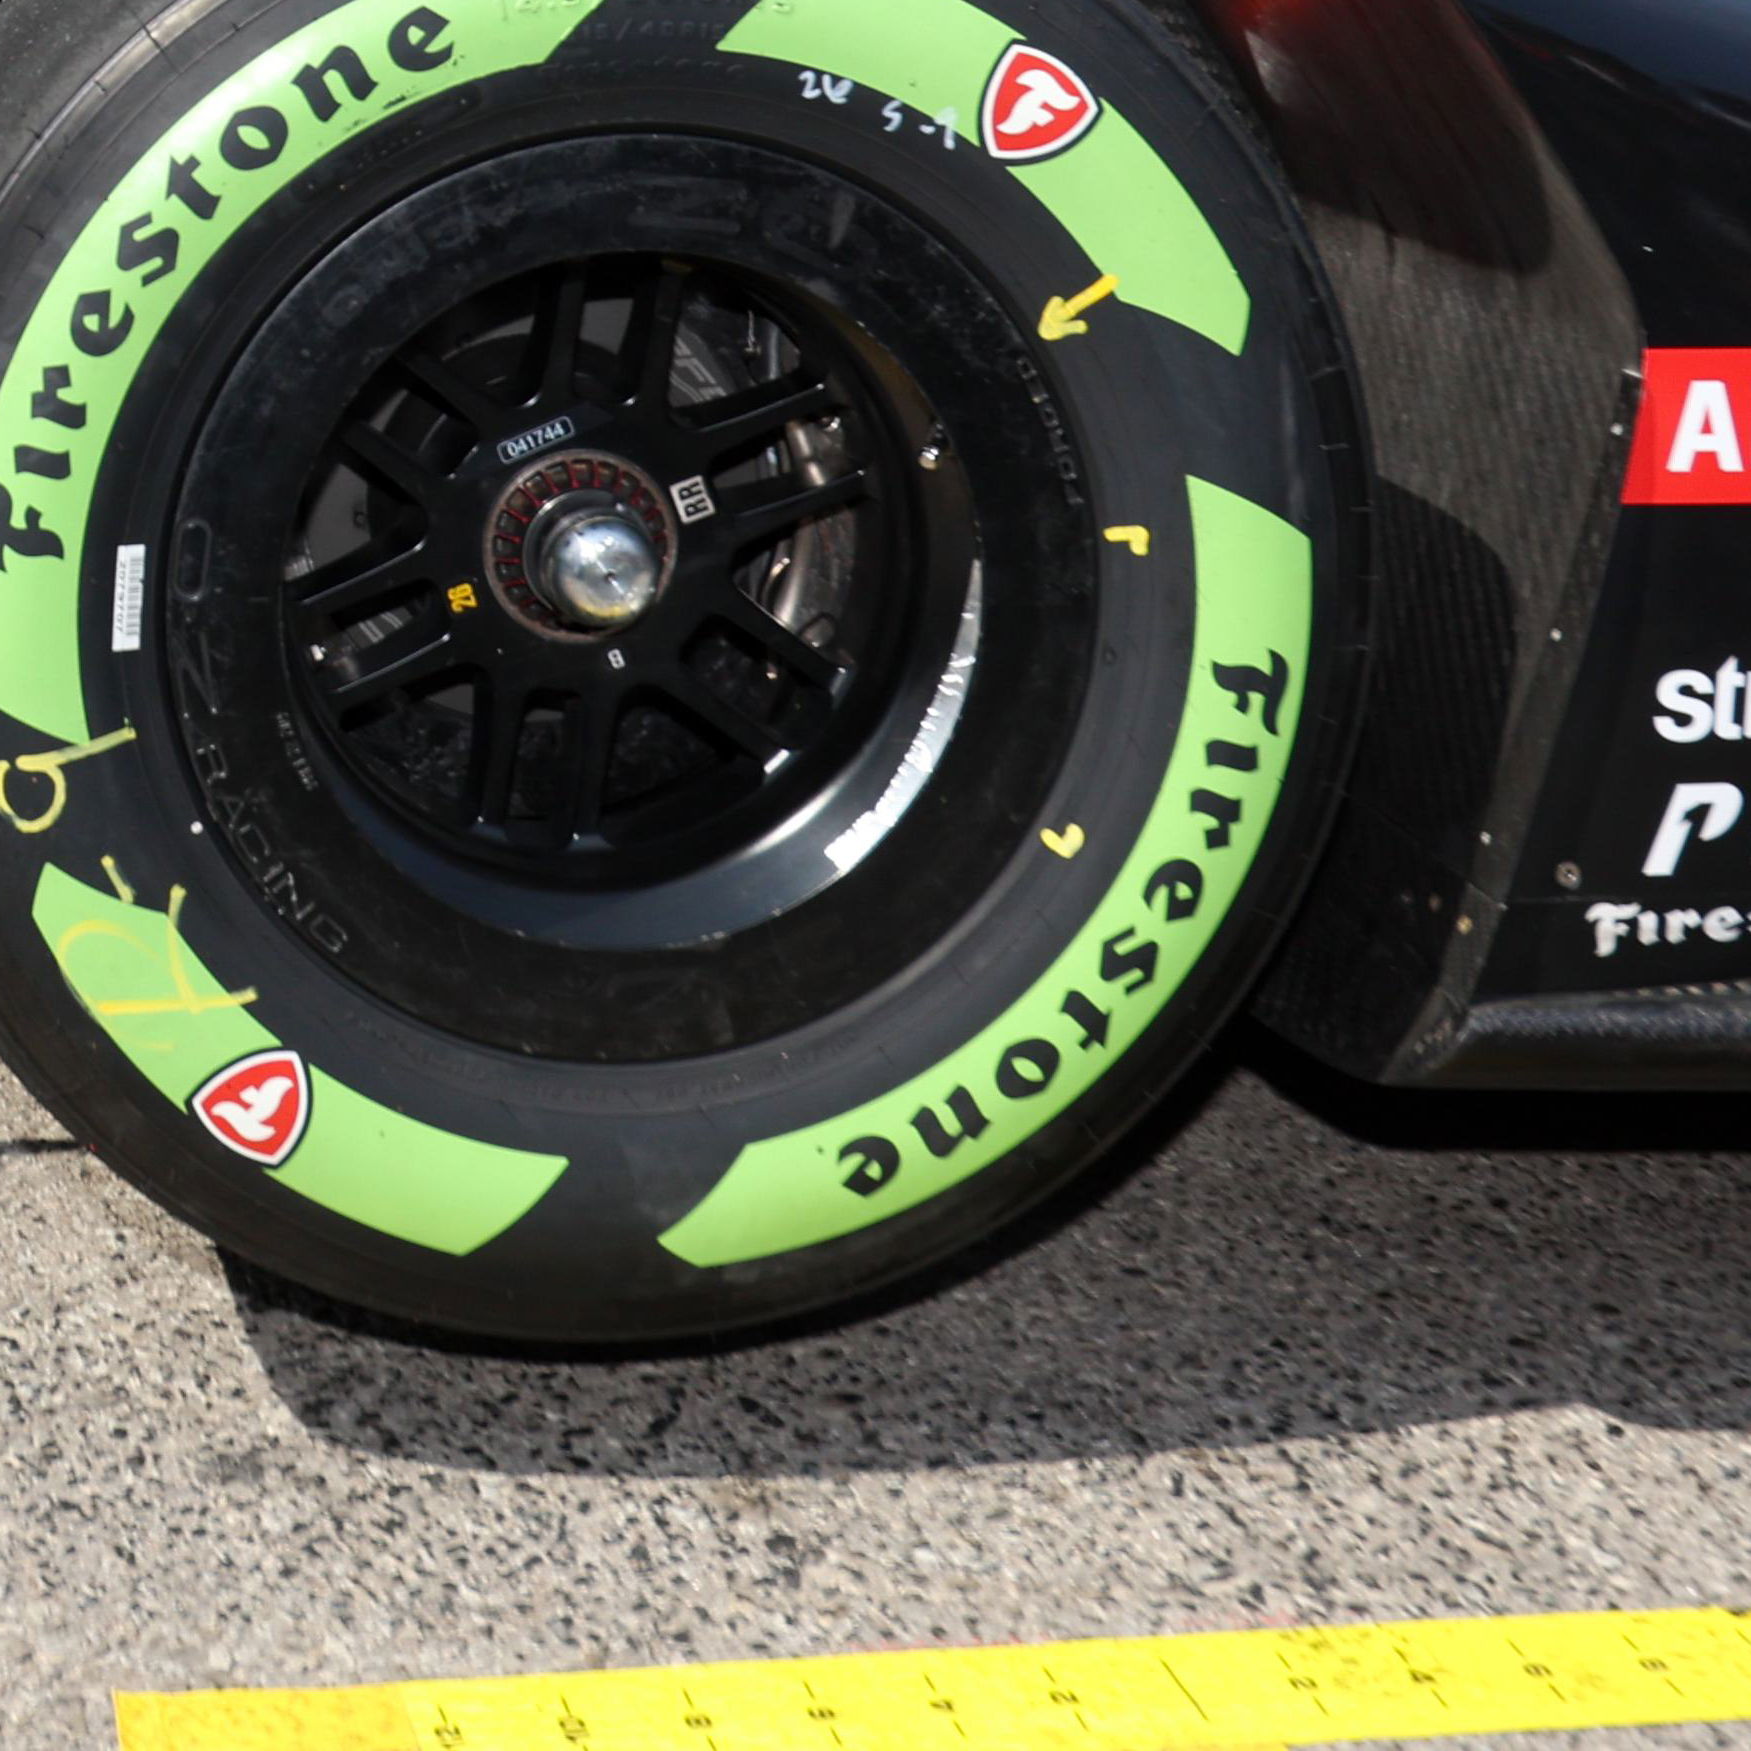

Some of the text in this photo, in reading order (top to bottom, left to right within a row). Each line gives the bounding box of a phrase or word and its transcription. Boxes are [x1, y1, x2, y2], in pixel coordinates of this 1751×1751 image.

[506, 421, 566, 457] 041744
[678, 481, 710, 520] RR
[837, 648, 1290, 1199] Firestone
